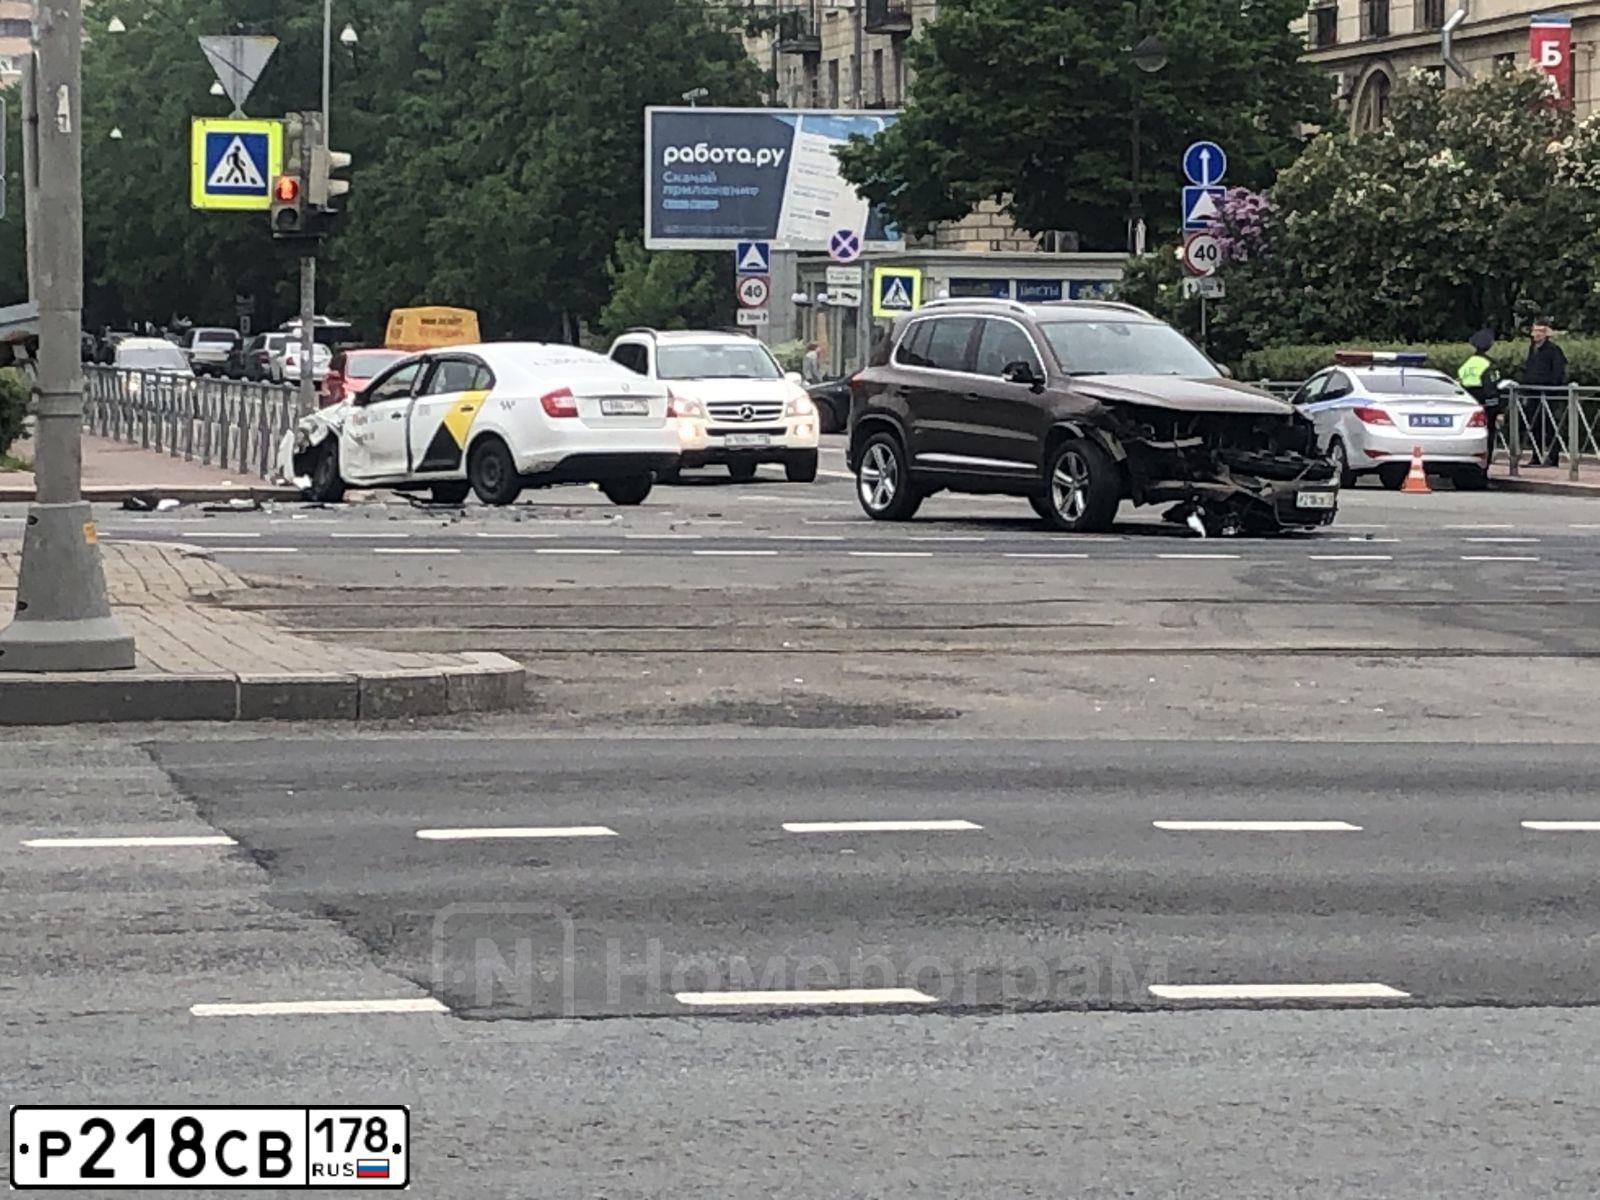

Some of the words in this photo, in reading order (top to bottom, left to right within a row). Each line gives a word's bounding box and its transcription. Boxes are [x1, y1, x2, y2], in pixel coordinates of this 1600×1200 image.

[663, 142, 785, 168] работа.ру
[1194, 244, 1217, 261] 40
[743, 284, 763, 298] 40
